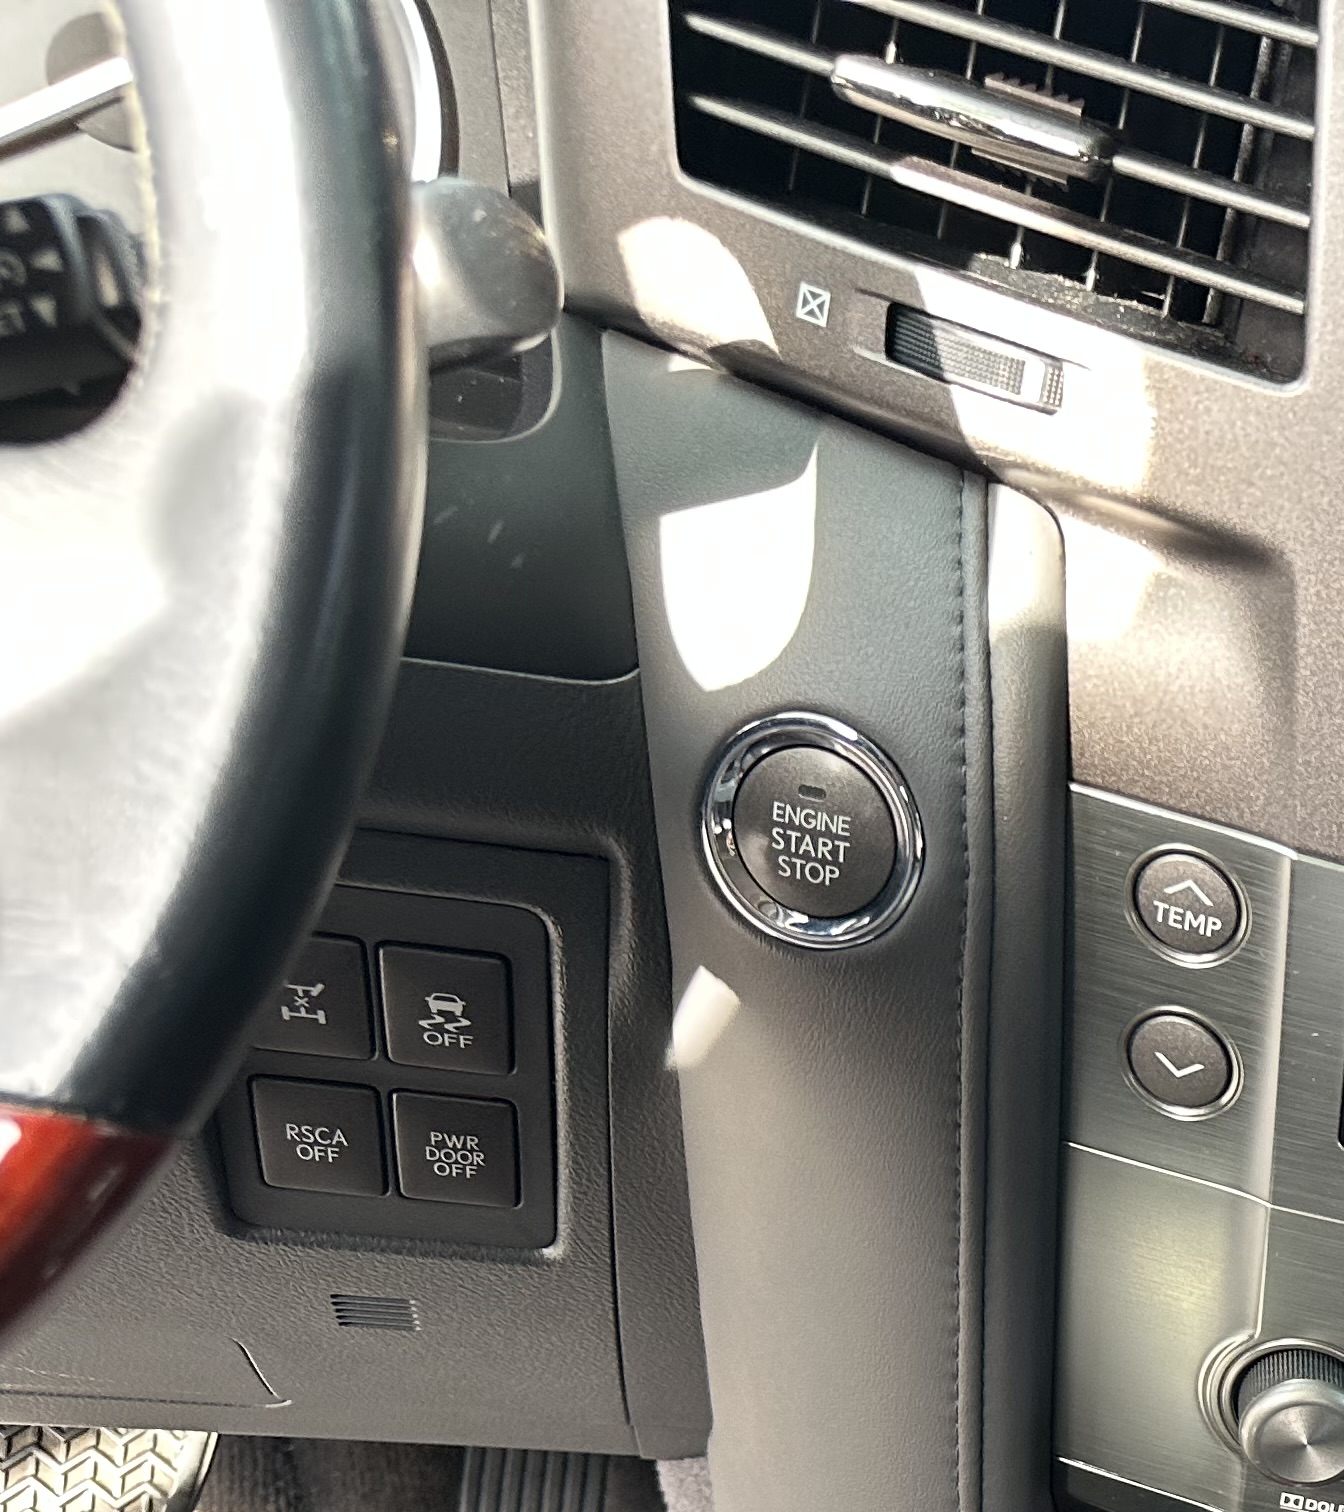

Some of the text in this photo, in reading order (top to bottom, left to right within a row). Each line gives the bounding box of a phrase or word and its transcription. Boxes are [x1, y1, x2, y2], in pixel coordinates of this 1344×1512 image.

[772, 800, 852, 837] ENGINE
[771, 826, 851, 863] START
[777, 855, 840, 886] STOP
[1152, 900, 1223, 938] TEMP
[423, 1031, 474, 1049] OFF
[286, 1123, 349, 1147] RSCA
[430, 1131, 480, 1150] PWR
[295, 1144, 340, 1163] OFF
[425, 1145, 485, 1166] DOOR
[433, 1162, 477, 1179] OFF
